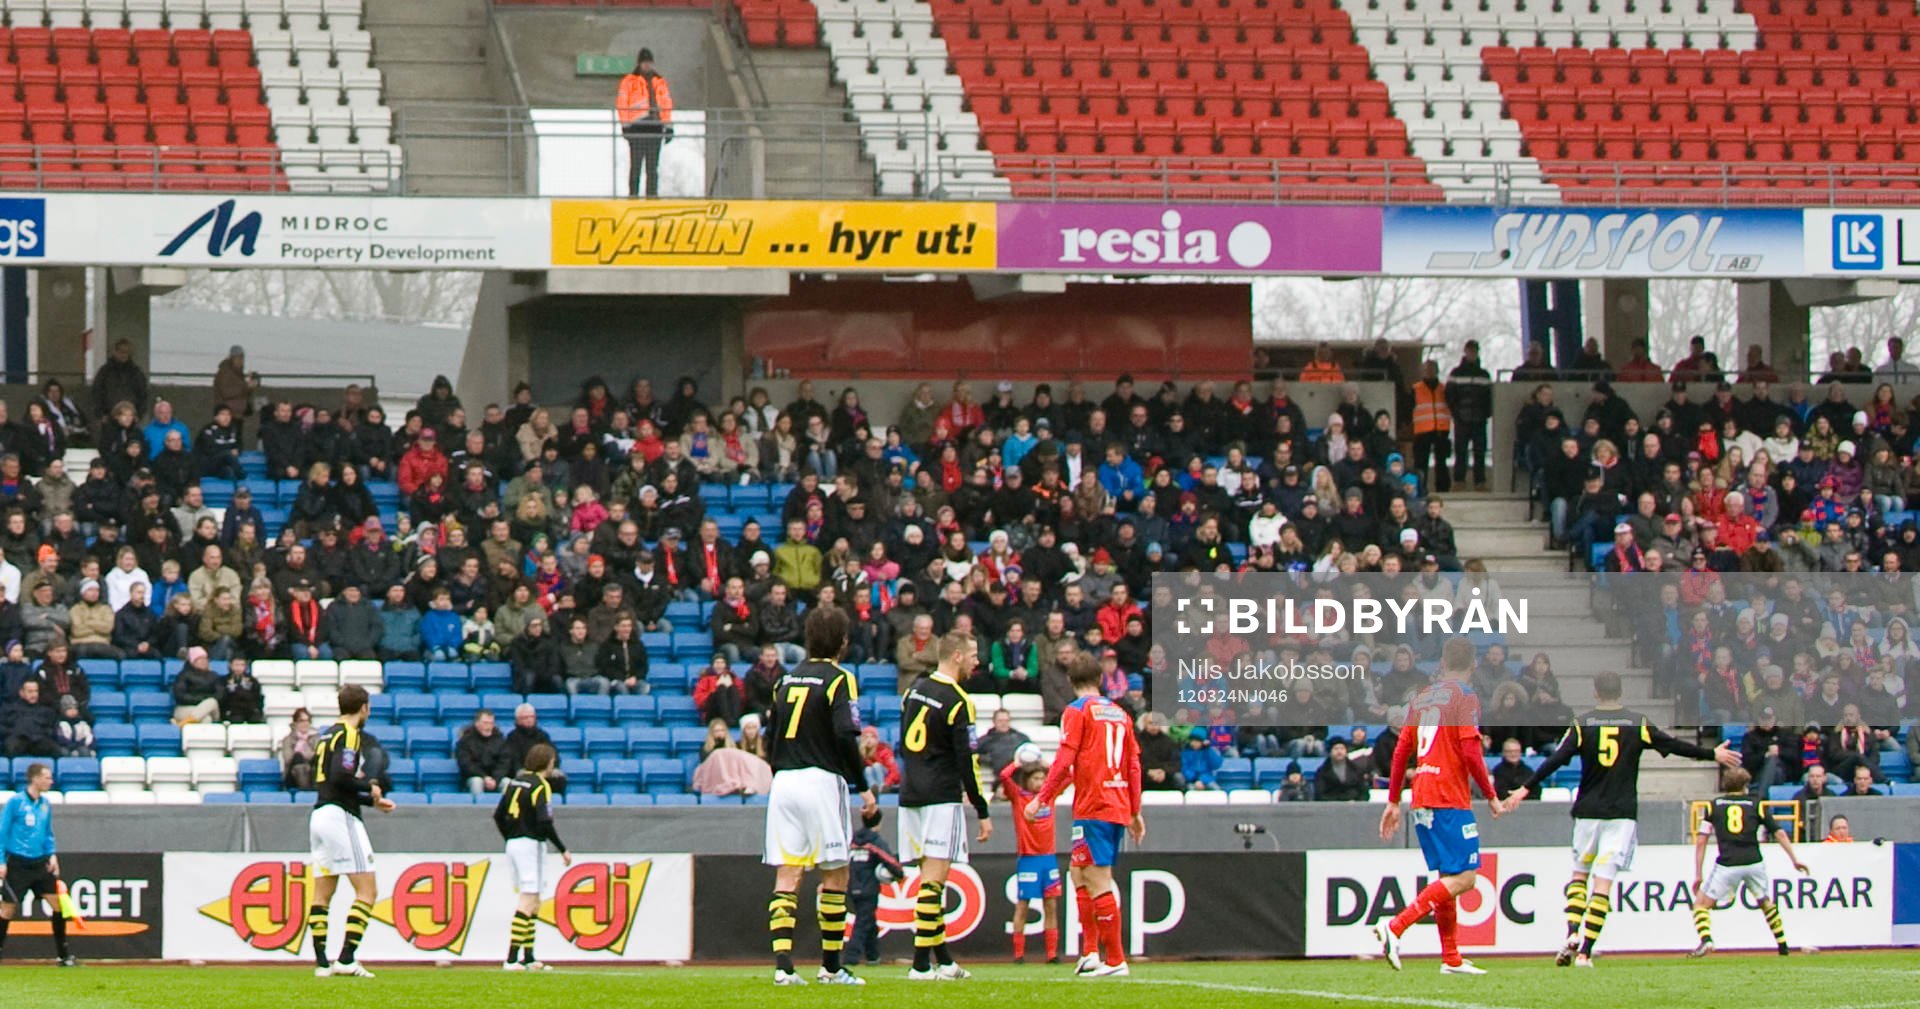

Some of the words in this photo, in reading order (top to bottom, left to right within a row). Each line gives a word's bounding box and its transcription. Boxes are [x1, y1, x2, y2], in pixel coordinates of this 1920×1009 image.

[281, 216, 389, 231] MIDROC
[828, 221, 903, 261] hyr
[916, 223, 977, 255] ut!
[1058, 210, 1220, 264] resia
[1473, 213, 1723, 273] SYDSPOL
[1840, 221, 1876, 263] LK
[280, 243, 363, 263] Property
[370, 244, 496, 261] Development
[1727, 257, 1752, 271] AB
[785, 686, 810, 739] 7
[904, 705, 929, 752] 6
[1104, 721, 1126, 769] 11
[1598, 726, 1620, 767] 5
[508, 786, 522, 819] 4
[1726, 804, 1743, 834] 8
